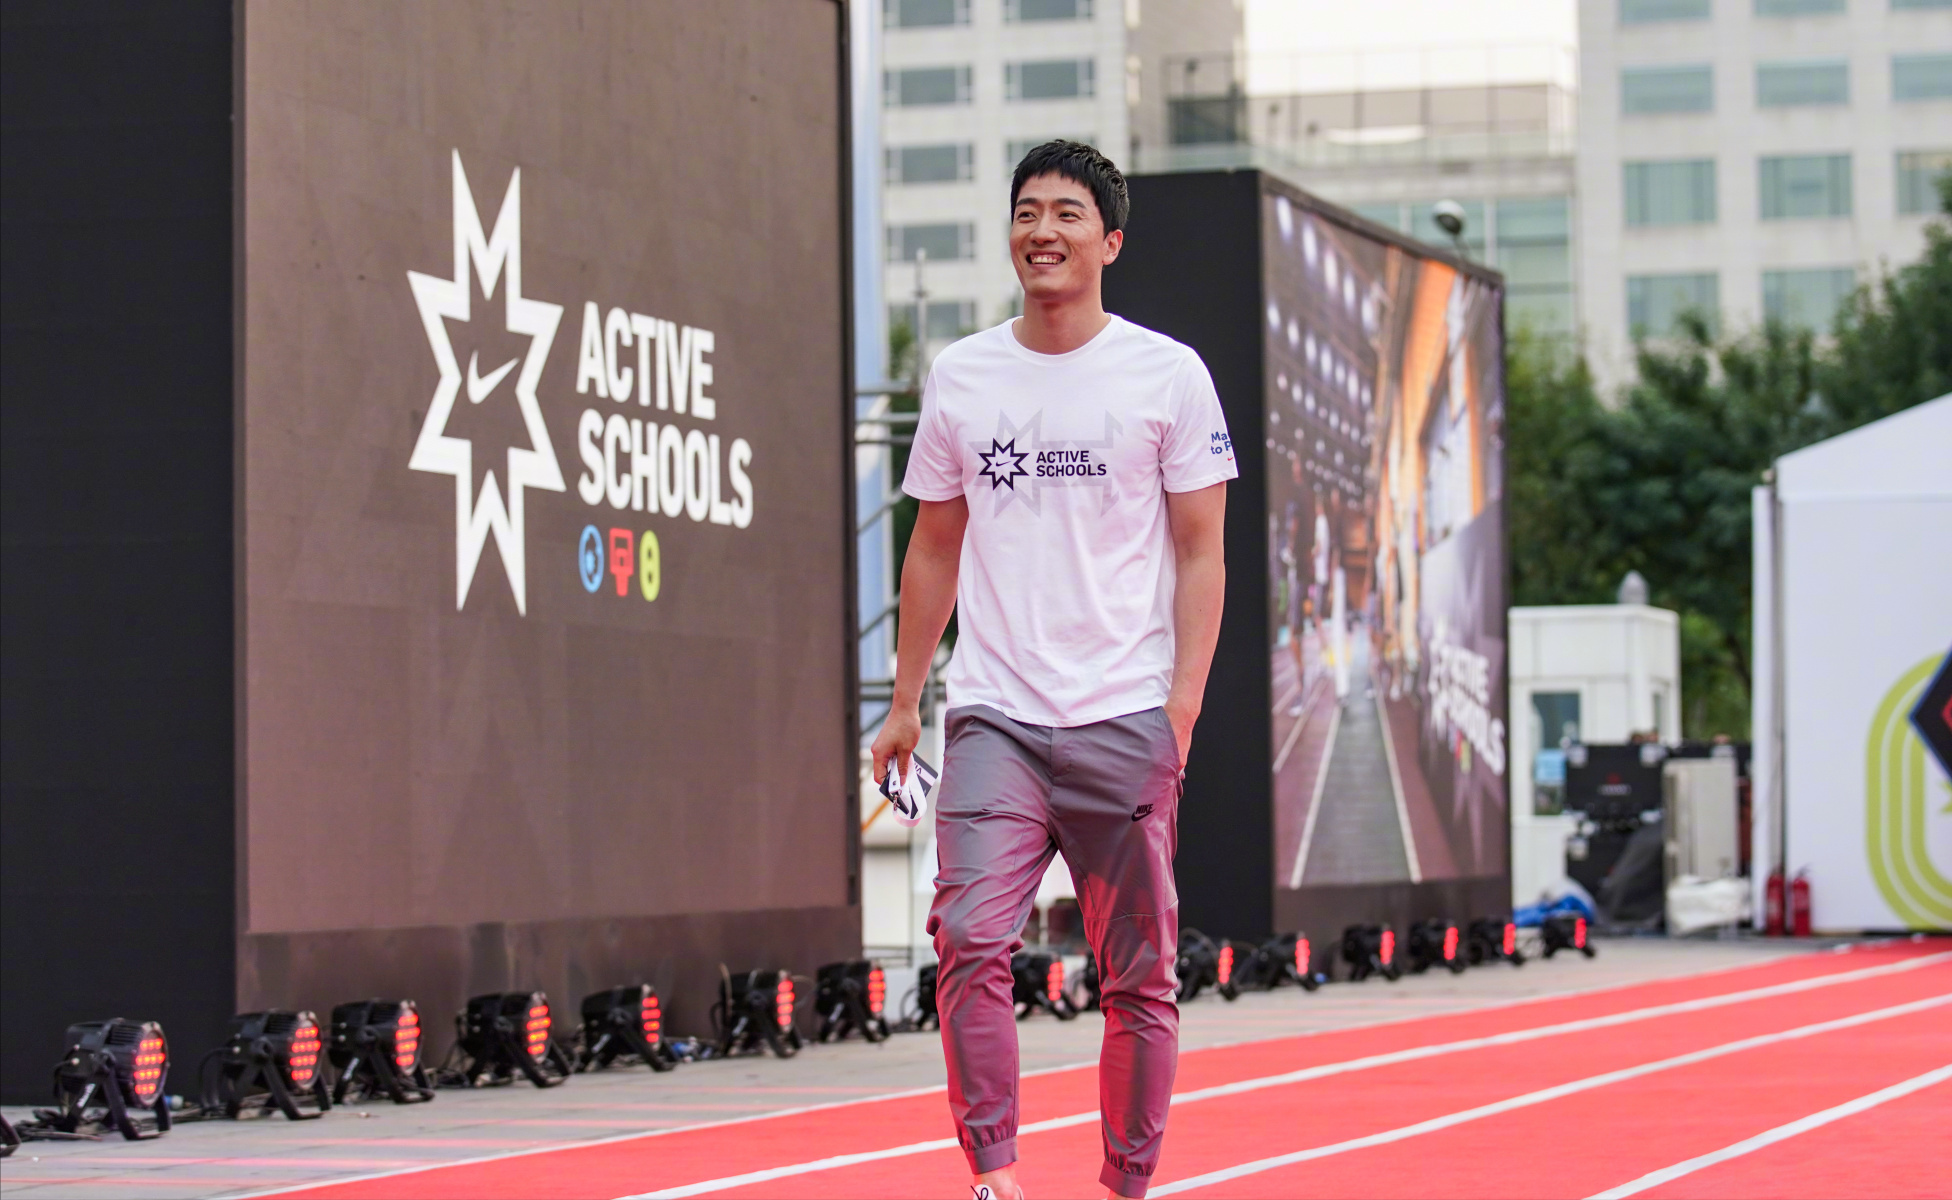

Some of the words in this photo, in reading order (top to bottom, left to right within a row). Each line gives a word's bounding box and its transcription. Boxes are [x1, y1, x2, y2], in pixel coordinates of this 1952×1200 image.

[576, 300, 716, 421] ACTIVE
[1036, 450, 1090, 464] ACTIVE
[1210, 445, 1223, 455] to
[577, 408, 754, 529] SCHOOLS
[1036, 463, 1108, 478] SCHOOLS
[1135, 803, 1154, 815] NIKE
